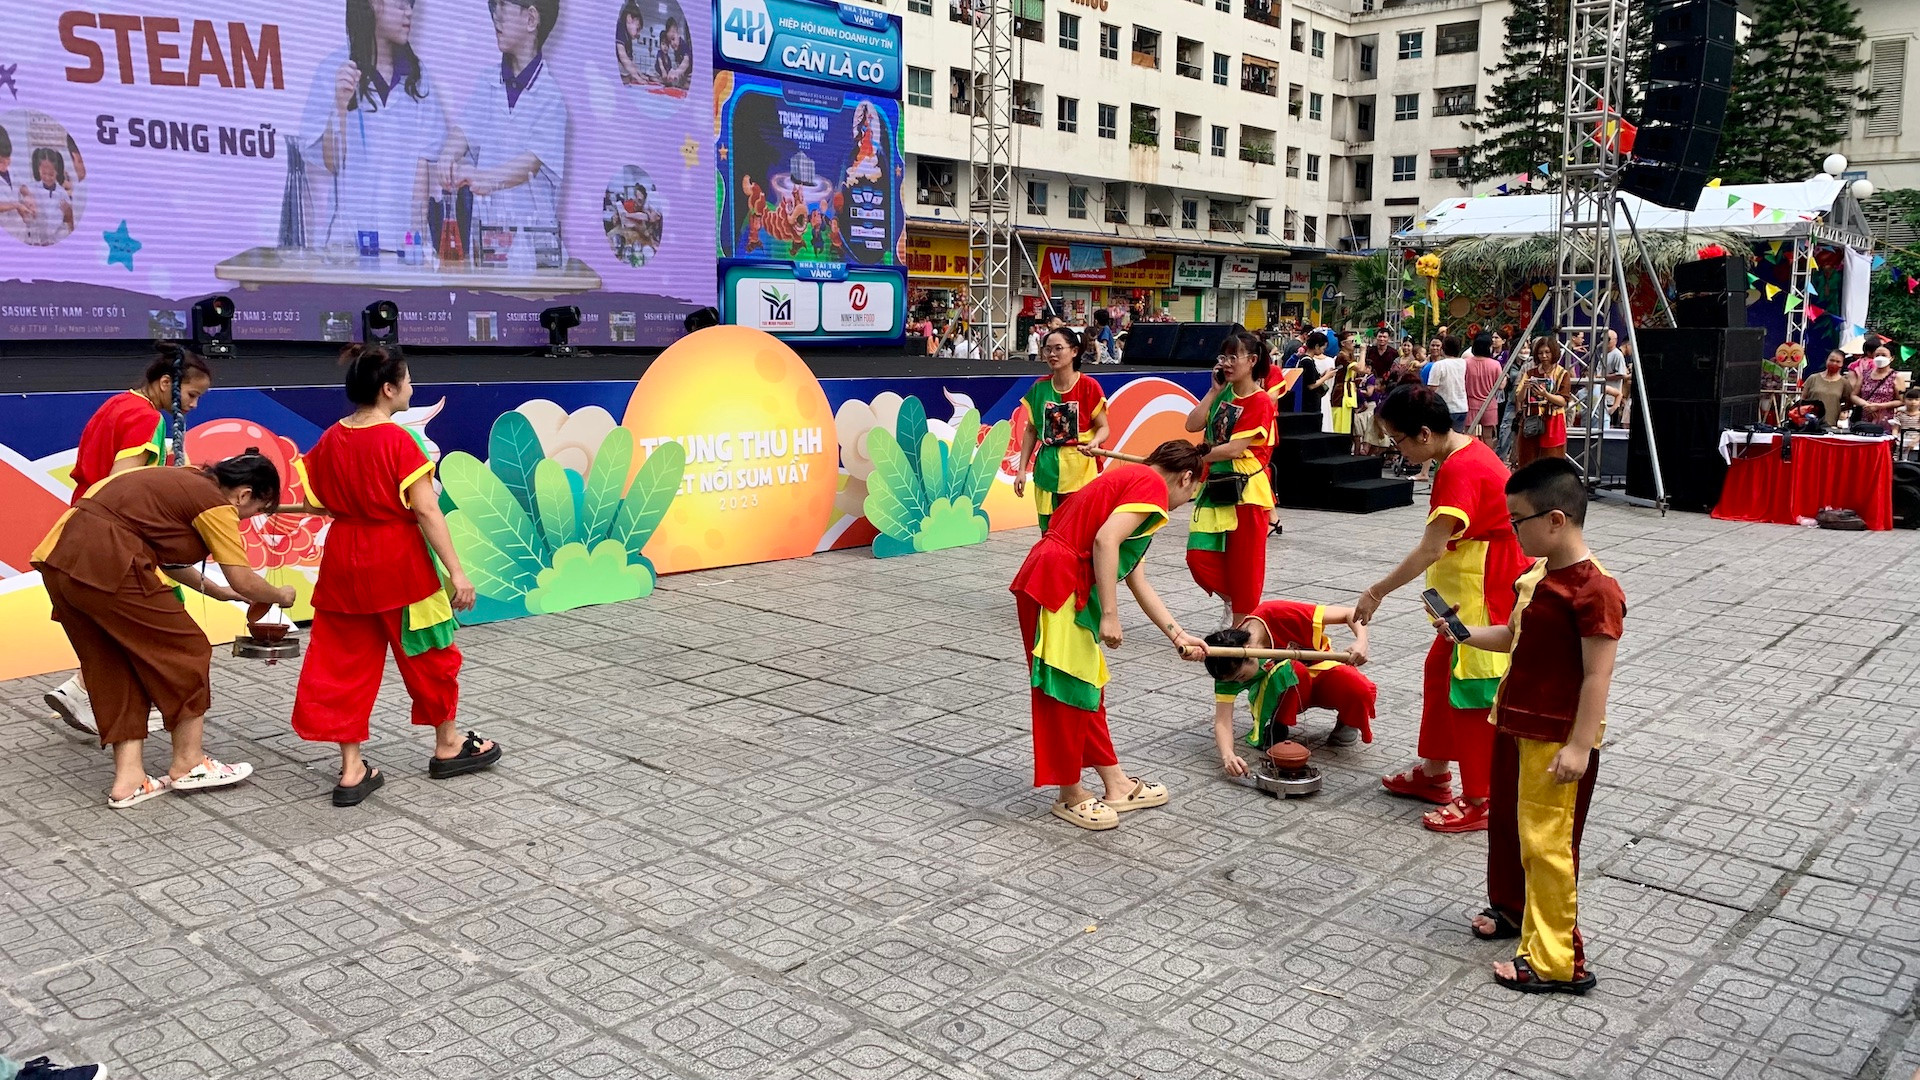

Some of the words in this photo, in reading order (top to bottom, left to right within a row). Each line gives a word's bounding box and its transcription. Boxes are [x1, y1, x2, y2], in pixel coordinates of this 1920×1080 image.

[778, 17, 800, 31] HIỆP
[800, 22, 816, 35] HỘI
[817, 26, 838, 38] KINH
[839, 31, 868, 45] DOANH
[869, 37, 880, 47] UY
[881, 37, 893, 49] TÍN
[853, 14, 875, 26] VÀNG
[58, 10, 285, 90] STEAM
[782, 41, 826, 73] CẦN
[829, 51, 853, 79] LÀ
[857, 58, 884, 84] CÓ
[96, 114, 119, 145] &
[128, 117, 210, 153] SONG
[218, 123, 276, 159] NGỮ
[811, 270, 832, 278] VÀNG
[1, 305, 38, 318] SASUKE
[40, 302, 60, 320] VIỆT
[62, 306, 82, 317] NAM
[92, 306, 104, 318] CƠ
[121, 307, 126, 318] 1
[243, 310, 260, 320] NAM
[262, 310, 266, 320] 3
[296, 310, 300, 320] 3
[738, 429, 788, 460] THU
[792, 427, 823, 456] HH
[700, 461, 733, 493] NỐI
[736, 467, 773, 490] SUM
[720, 495, 759, 511] 2023
